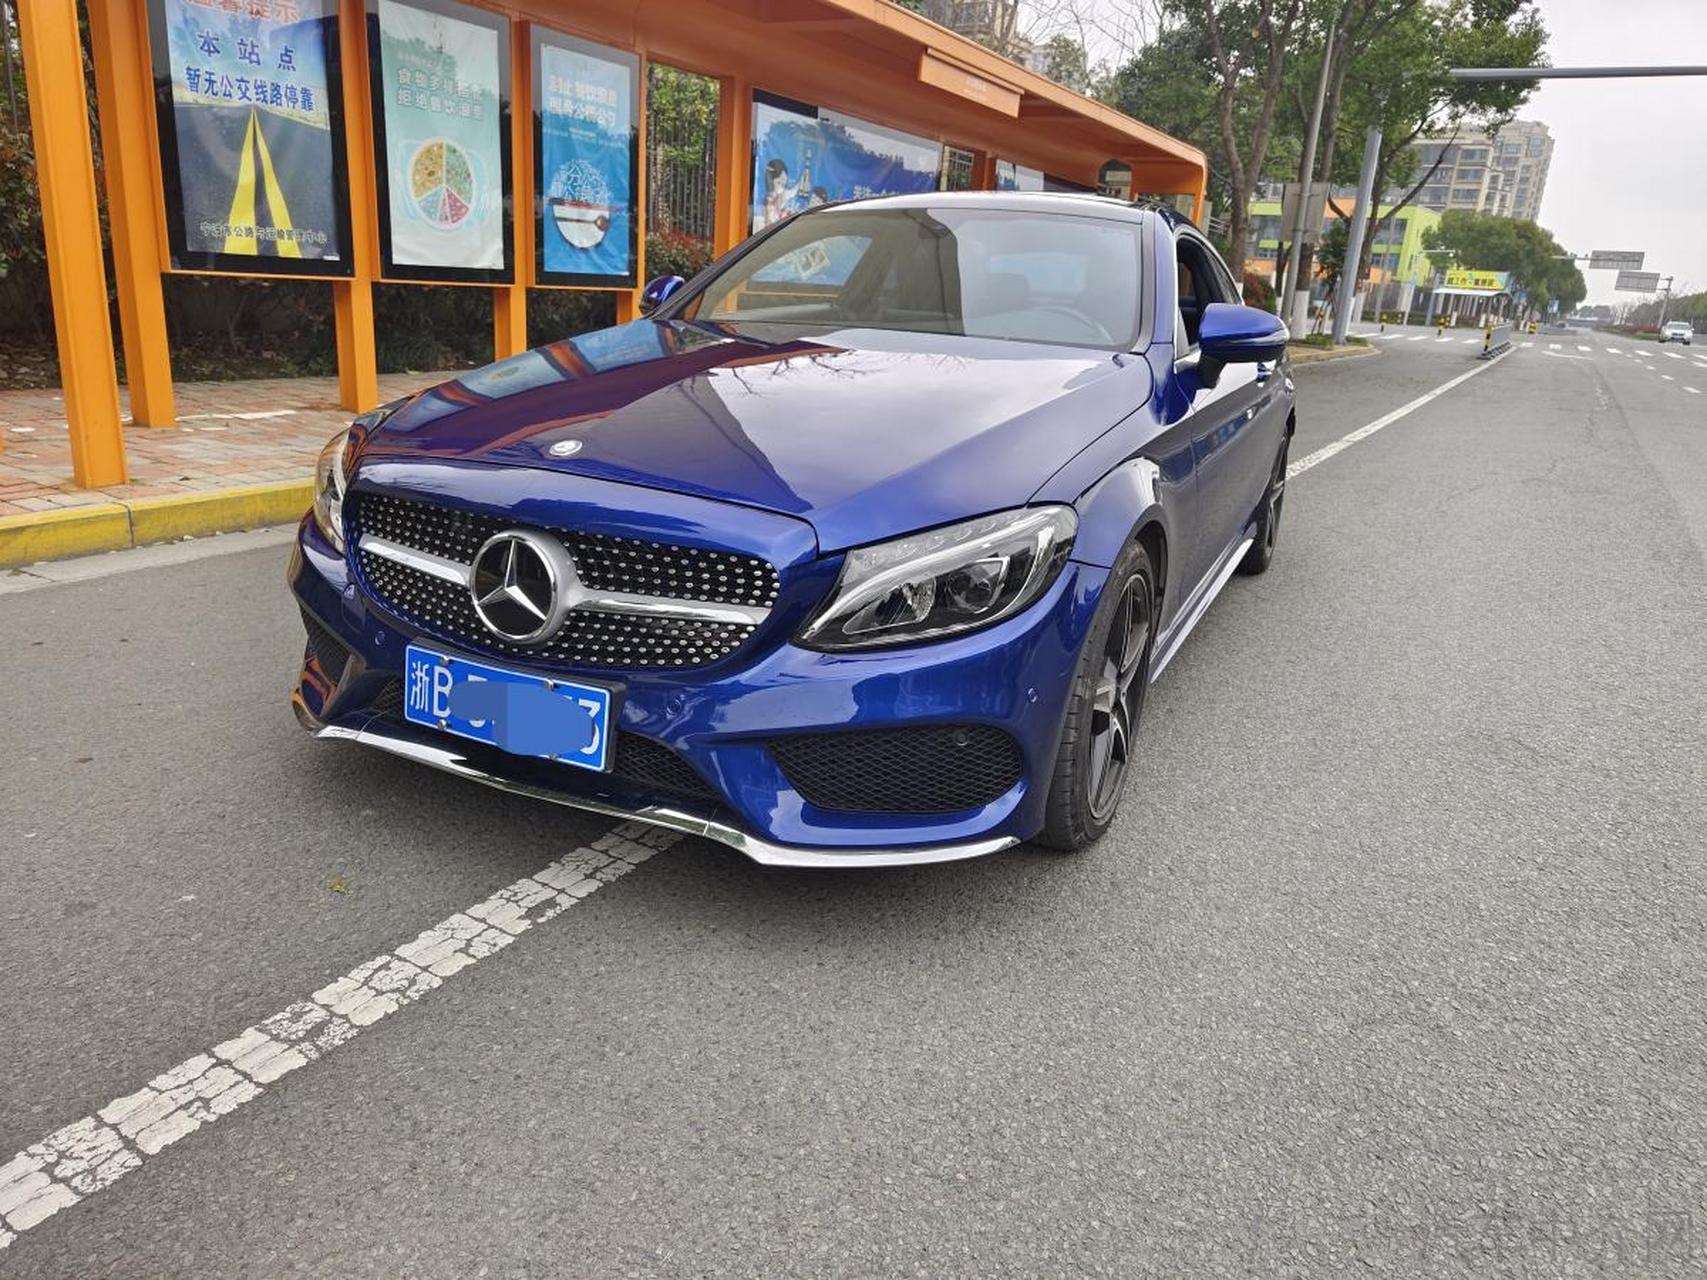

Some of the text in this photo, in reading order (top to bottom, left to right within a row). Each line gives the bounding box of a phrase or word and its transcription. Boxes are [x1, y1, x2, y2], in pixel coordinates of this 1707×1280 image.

[197, 31, 297, 72] 本站点
[185, 65, 314, 112] 暂无公交线路停靠
